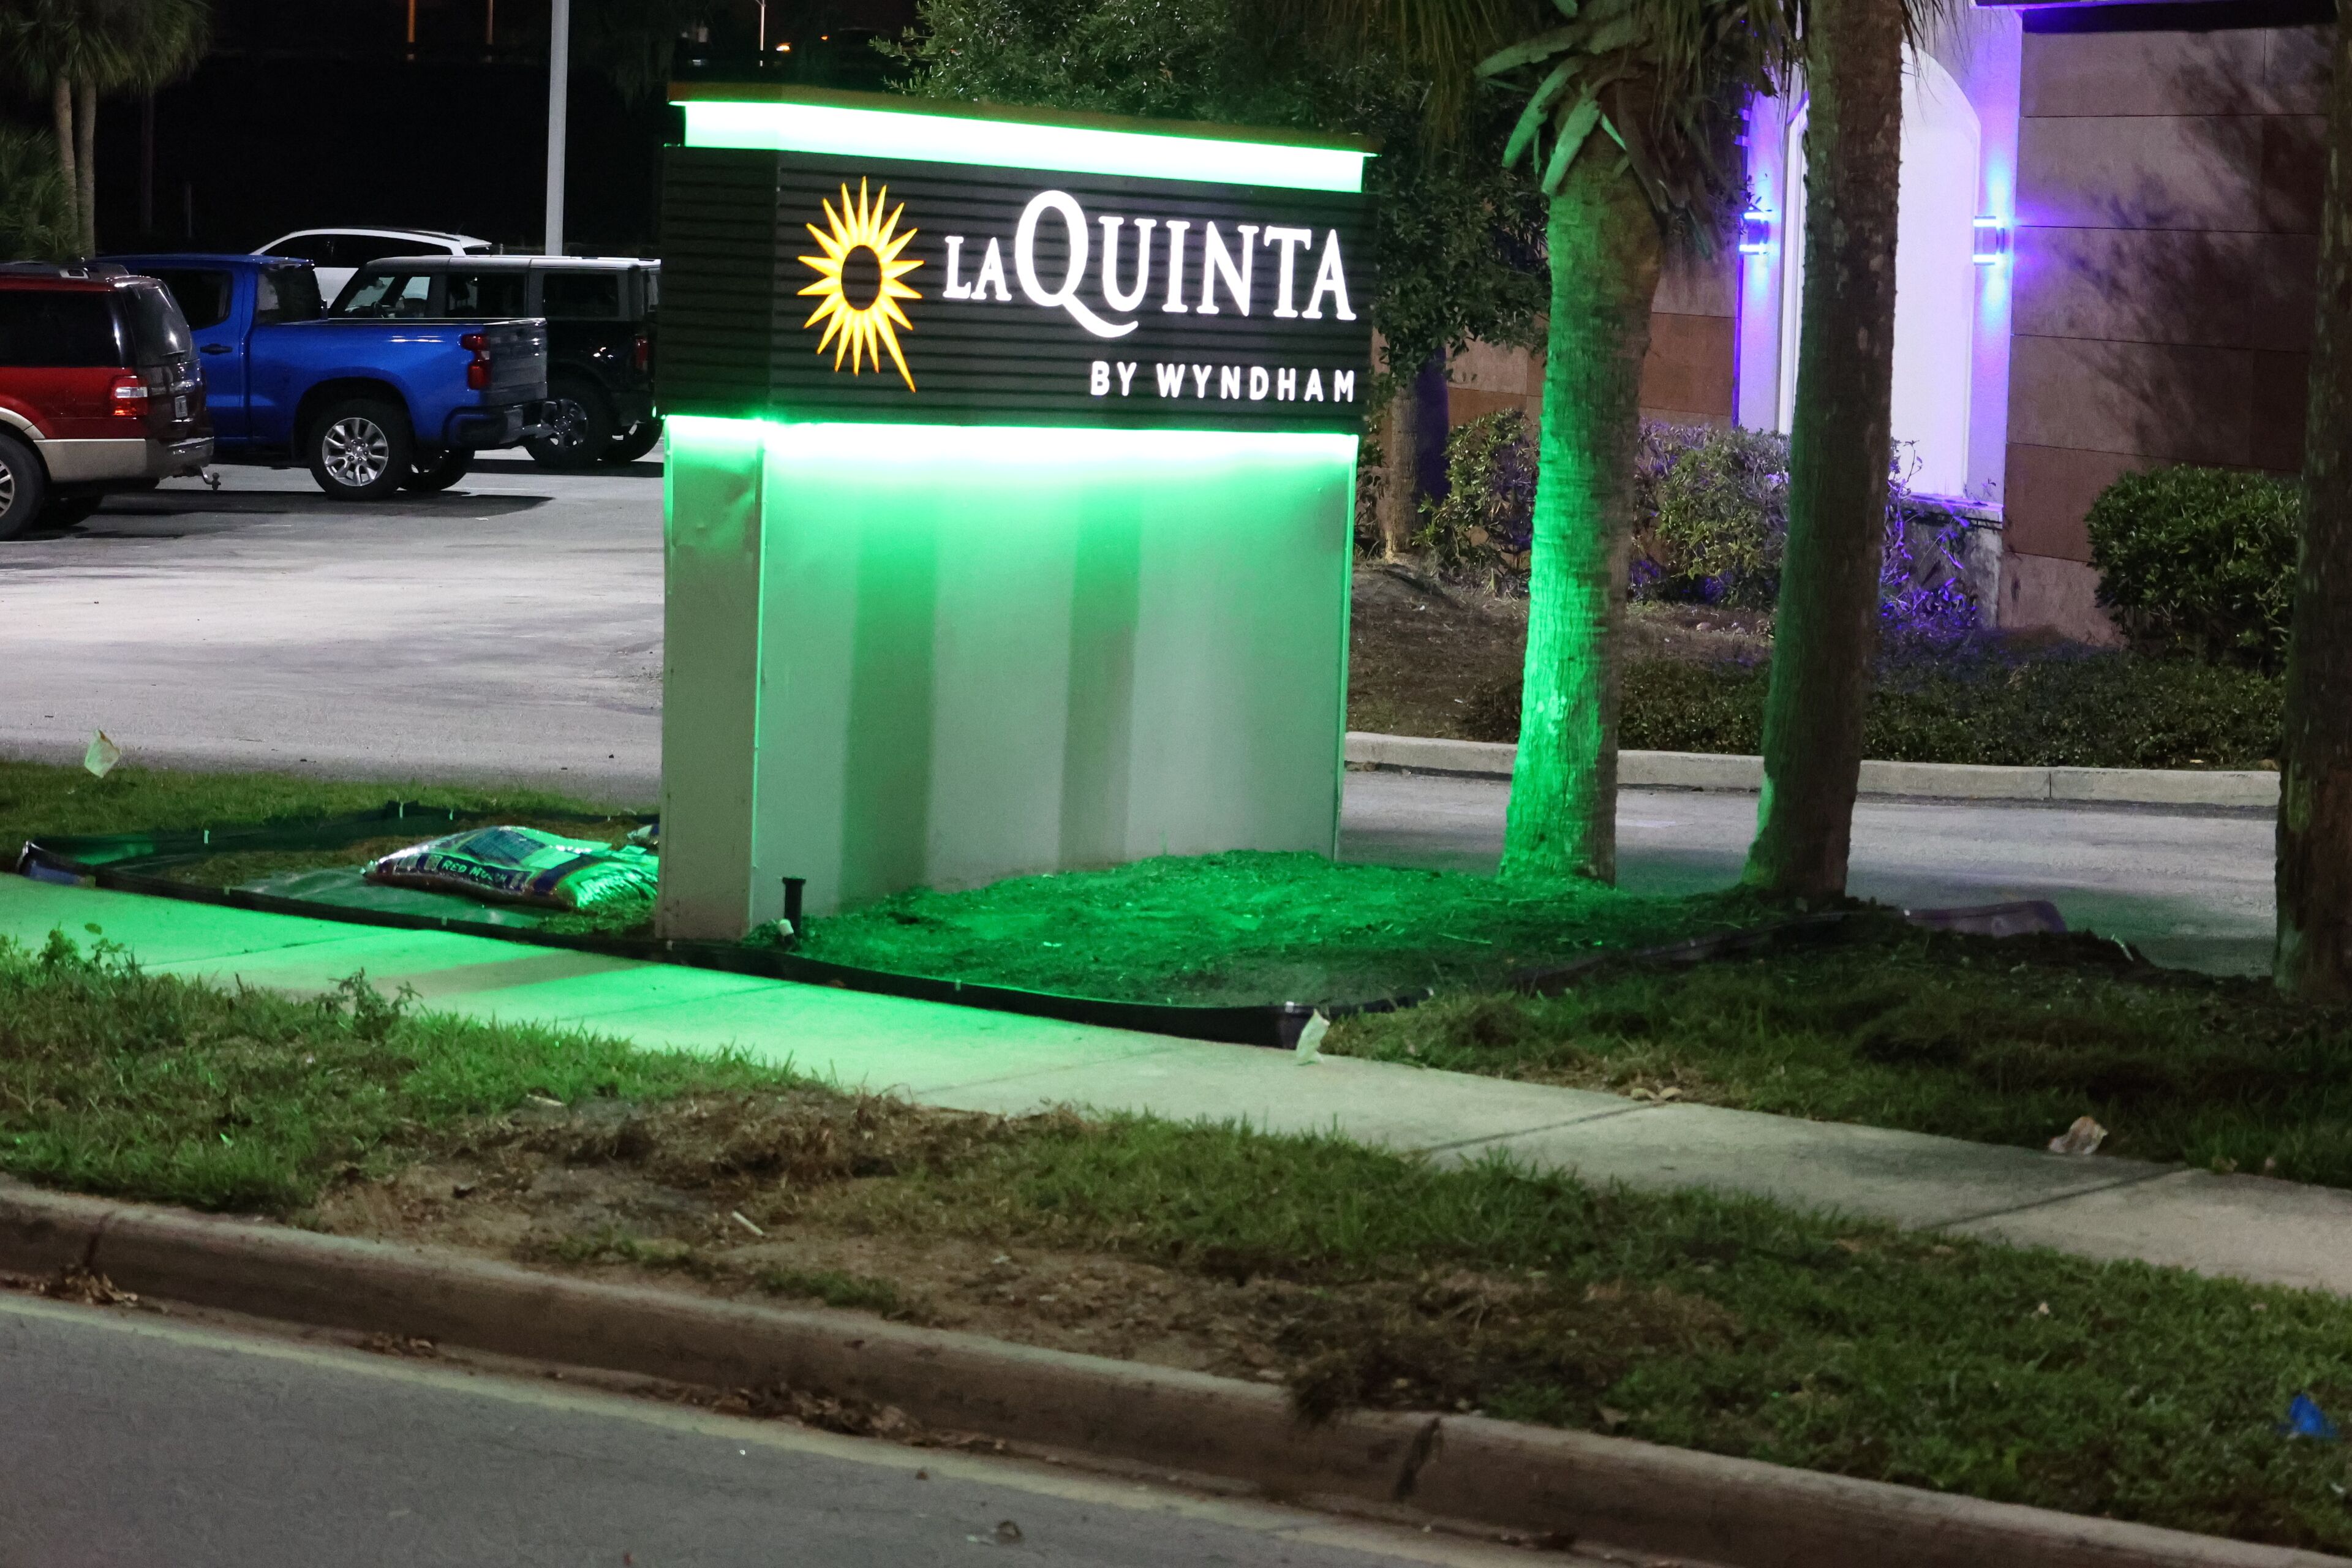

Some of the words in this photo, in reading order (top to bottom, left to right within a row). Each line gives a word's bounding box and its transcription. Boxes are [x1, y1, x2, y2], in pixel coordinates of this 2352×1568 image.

[942, 235, 1012, 302] LA
[1013, 189, 1357, 339] QUINTA
[1090, 360, 1137, 398] BY
[1155, 363, 1355, 402] WYNDHAM
[441, 859, 467, 873] RED
